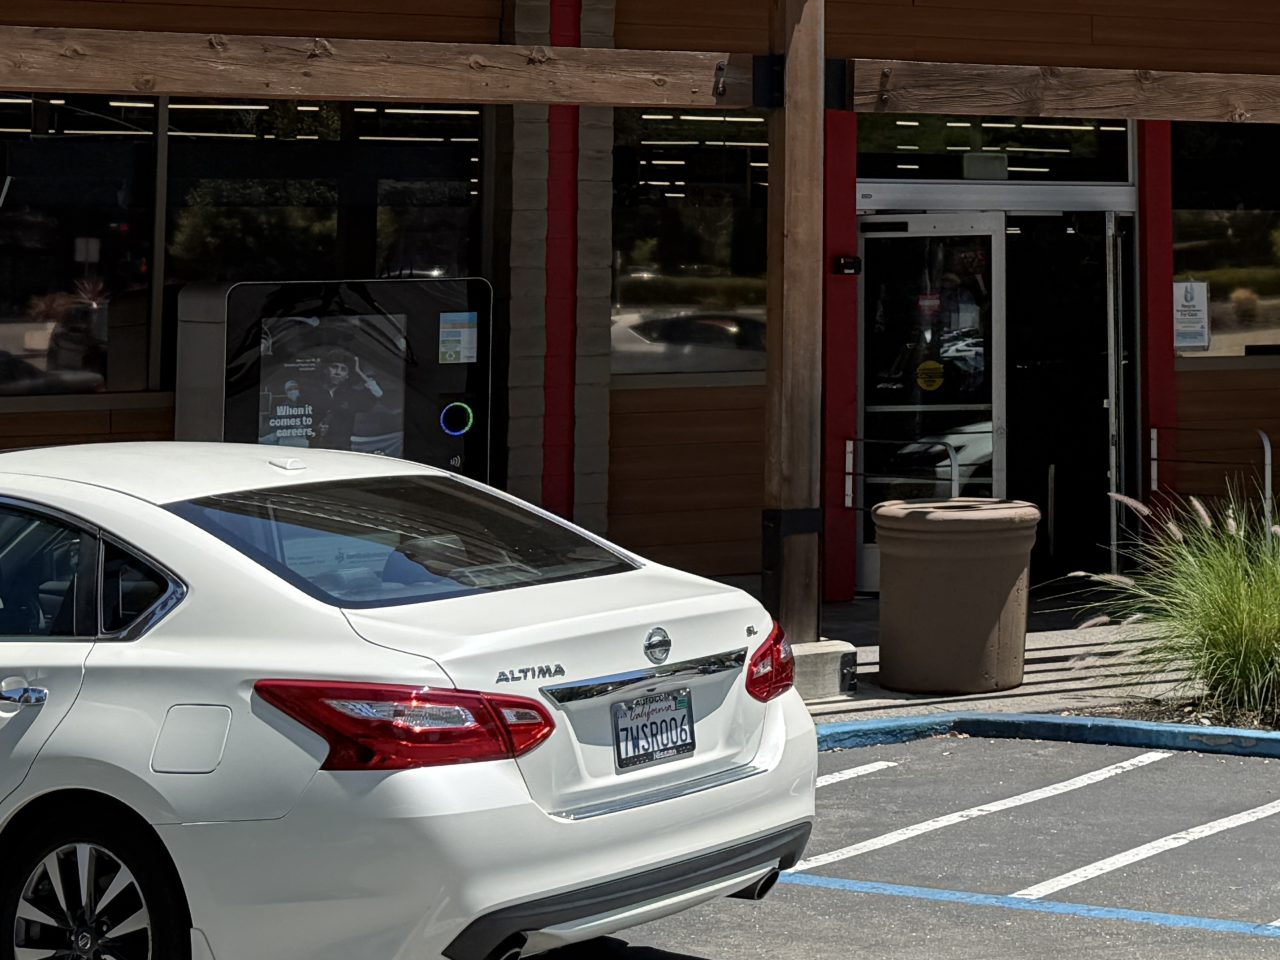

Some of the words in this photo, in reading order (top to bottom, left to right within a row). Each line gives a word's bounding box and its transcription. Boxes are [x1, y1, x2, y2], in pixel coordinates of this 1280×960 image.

[276, 405, 304, 416] When
[305, 404, 313, 415] it
[269, 417, 302, 427] comes
[302, 416, 313, 426] to
[276, 428, 316, 438] careers,
[745, 625, 758, 637] SL
[495, 663, 566, 684] ALTIMA
[619, 714, 689, 757] 7WSR006
